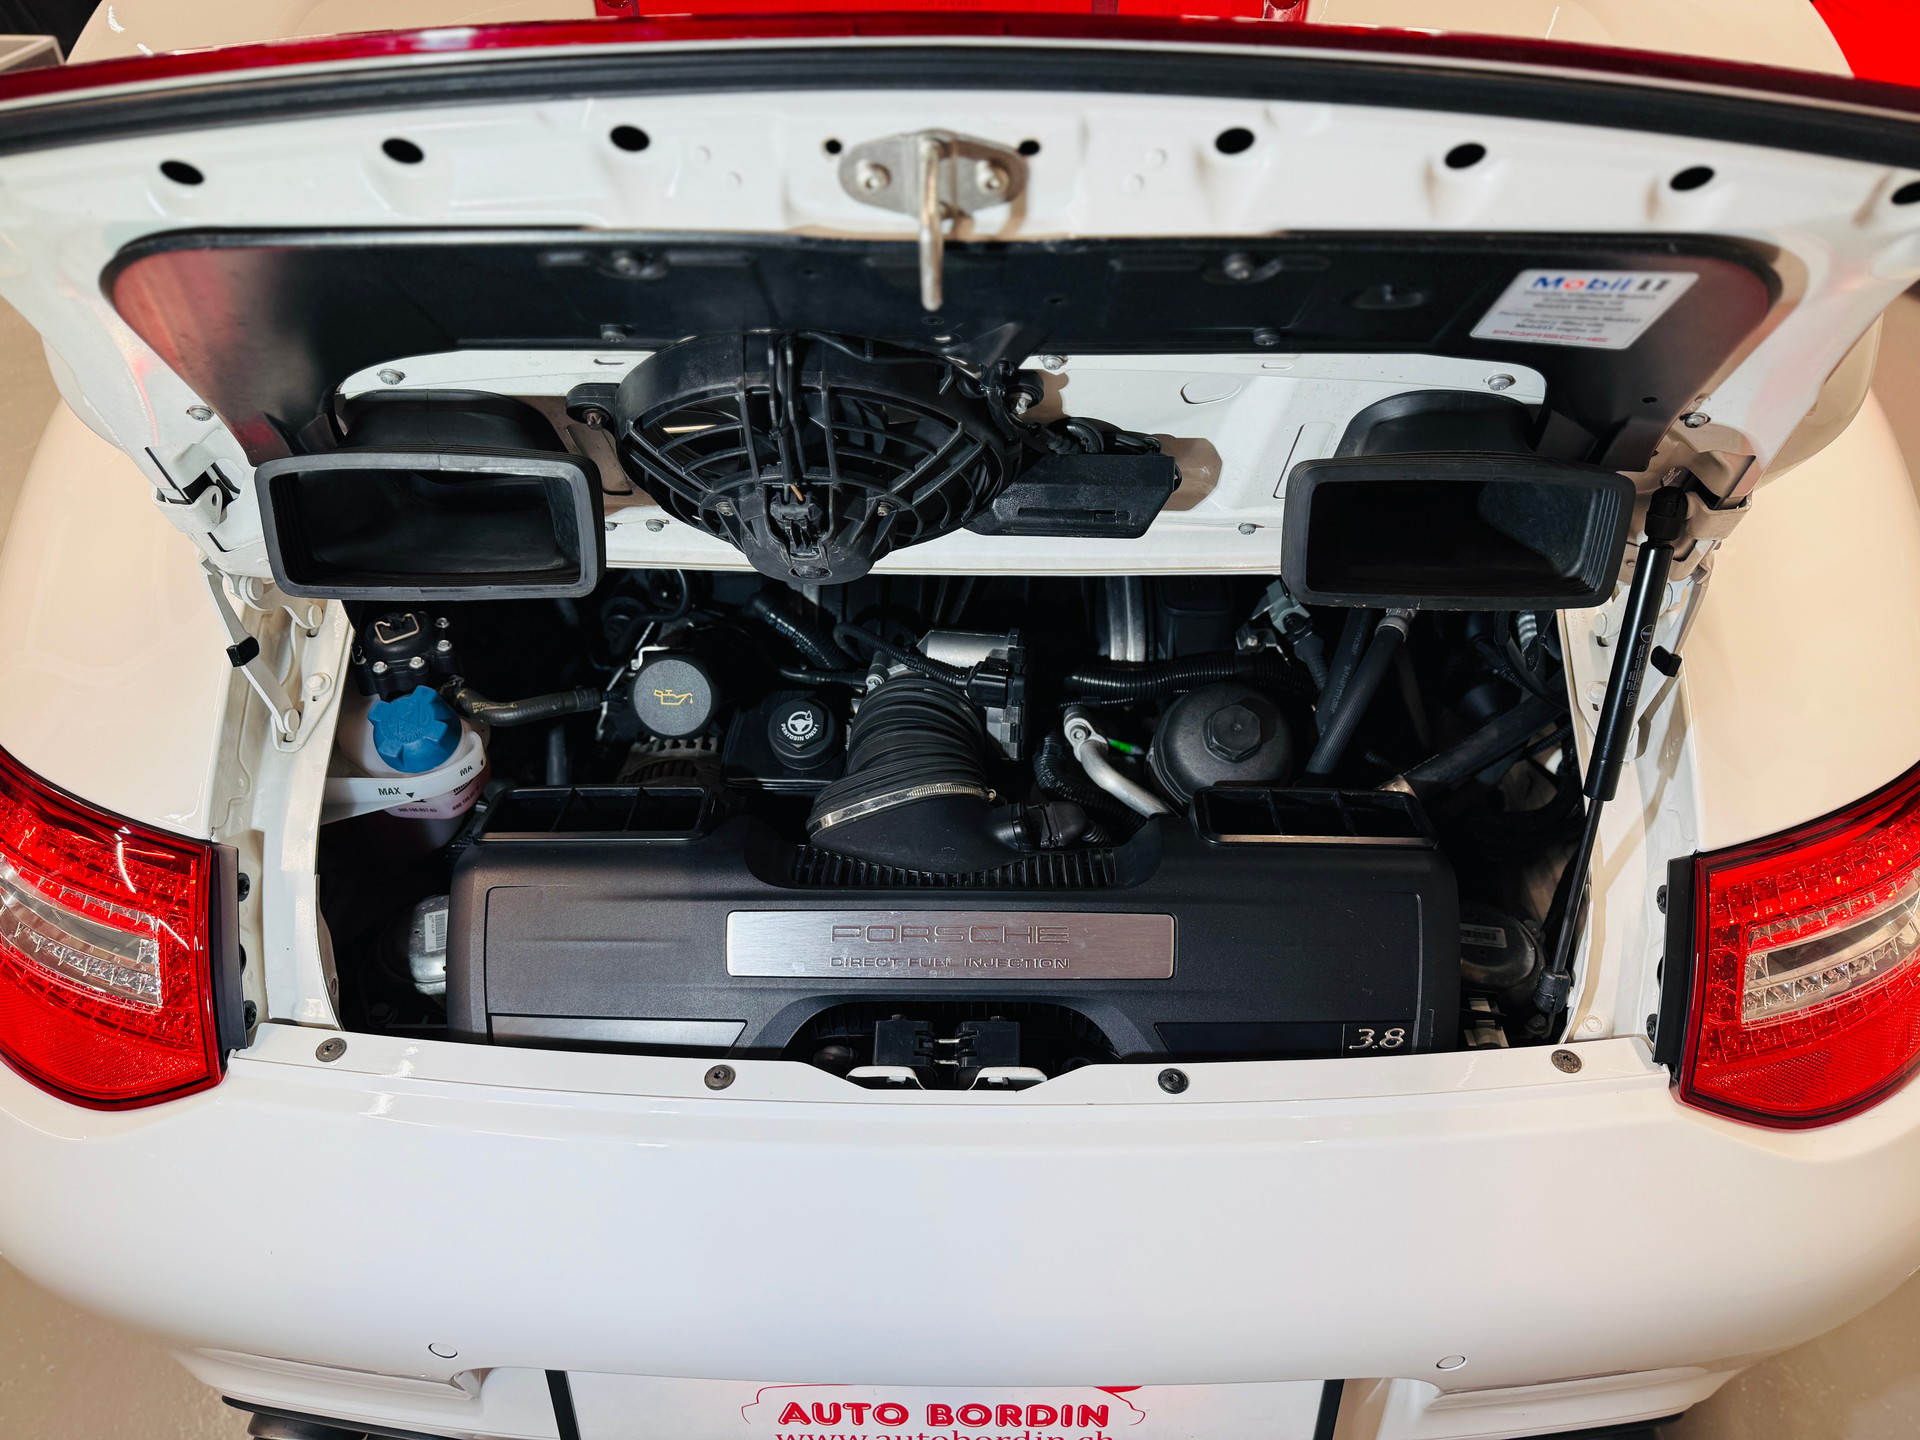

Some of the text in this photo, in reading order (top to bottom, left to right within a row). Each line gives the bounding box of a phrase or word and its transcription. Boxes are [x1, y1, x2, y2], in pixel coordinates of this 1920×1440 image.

[1532, 276, 1633, 291] Mobil
[1492, 329, 1610, 342] PORSCHE
[781, 723, 805, 741] PENTOSIN
[804, 727, 818, 740] ONLY
[378, 787, 401, 796] MAX
[831, 925, 1070, 944] PORSCHE
[830, 957, 1070, 969] DIRECT FUEL INJECTION
[1349, 1028, 1406, 1049] 3.8
[778, 1401, 1110, 1428] AUTO BORDIN
